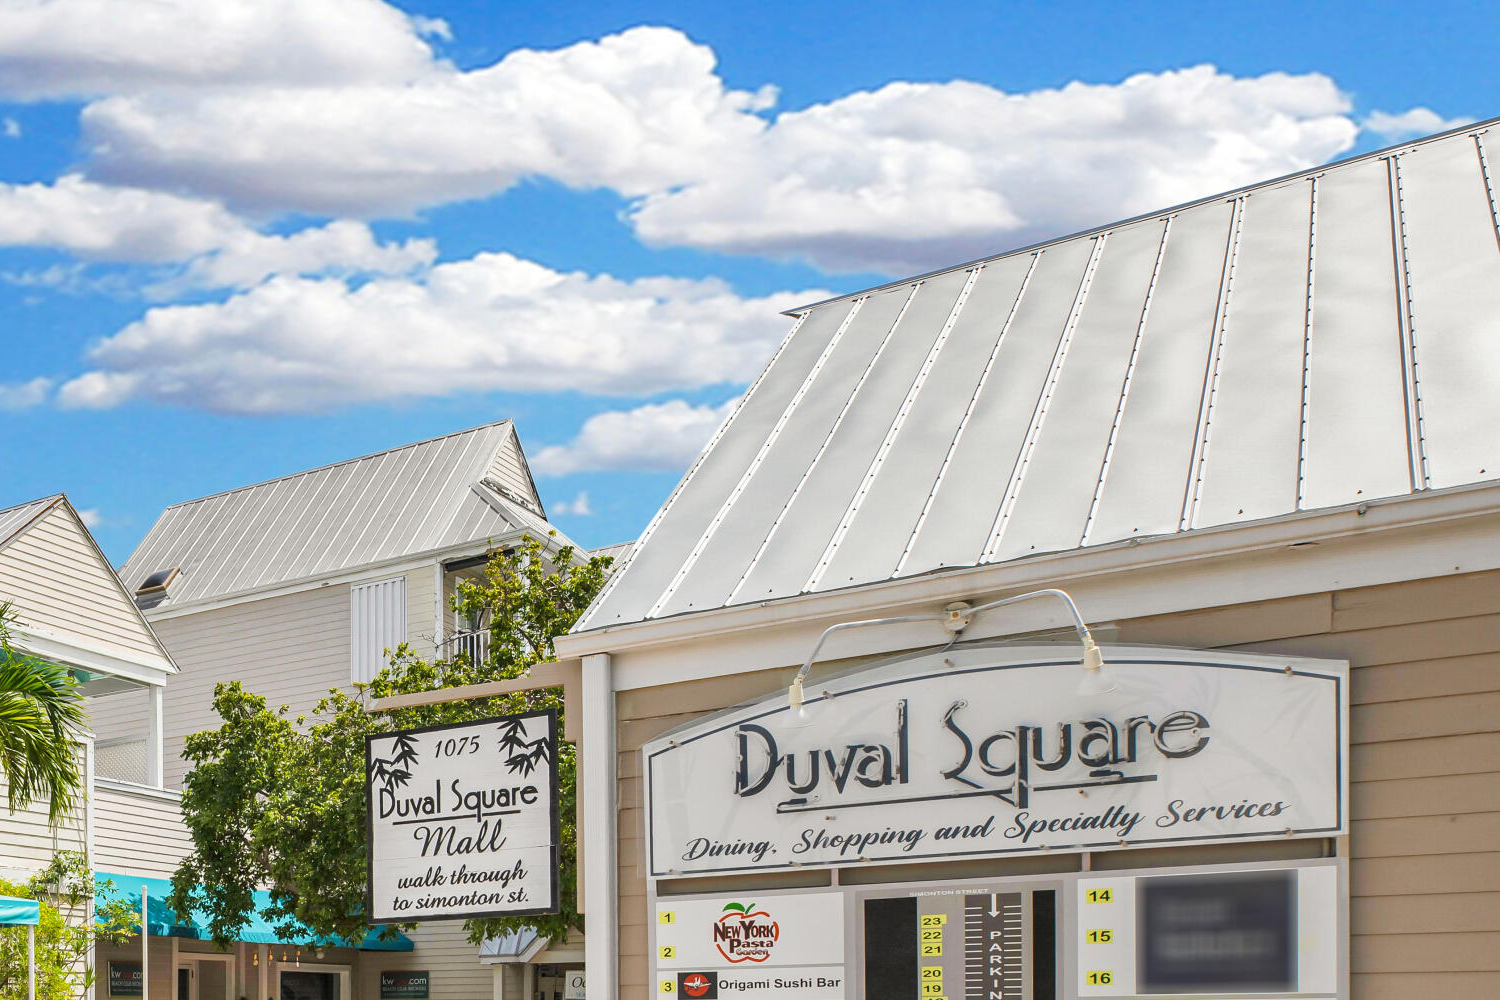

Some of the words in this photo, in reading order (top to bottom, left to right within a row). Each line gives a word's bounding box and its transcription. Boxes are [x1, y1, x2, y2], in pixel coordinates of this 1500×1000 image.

[435, 735, 480, 758] 1075
[733, 699, 908, 797] Duval
[940, 700, 1210, 809] Square
[380, 780, 441, 819] Duval
[452, 779, 538, 822] Square
[792, 828, 928, 855] Shopping
[934, 816, 995, 841] and
[1004, 805, 1146, 843] Specialty
[1155, 800, 1291, 828] Services
[414, 819, 506, 857] Mall
[398, 866, 448, 889] walk
[450, 860, 528, 888] through
[393, 896, 412, 910] to
[415, 893, 504, 909] simonton
[507, 887, 529, 902] st.
[910, 888, 953, 897] SIMONTON
[1090, 891, 1111, 901] 14
[663, 912, 671, 923] 1
[714, 922, 741, 942] NEW
[739, 920, 775, 940] YORK
[1090, 931, 1111, 941] 15
[663, 947, 672, 957] 2
[730, 938, 774, 953] Pasta
[736, 948, 769, 956] Garden
[719, 979, 769, 991] Origami
[774, 978, 812, 988] Sushi
[817, 977, 841, 988] Bar
[1090, 973, 1111, 983] 16
[664, 982, 672, 992] 3
